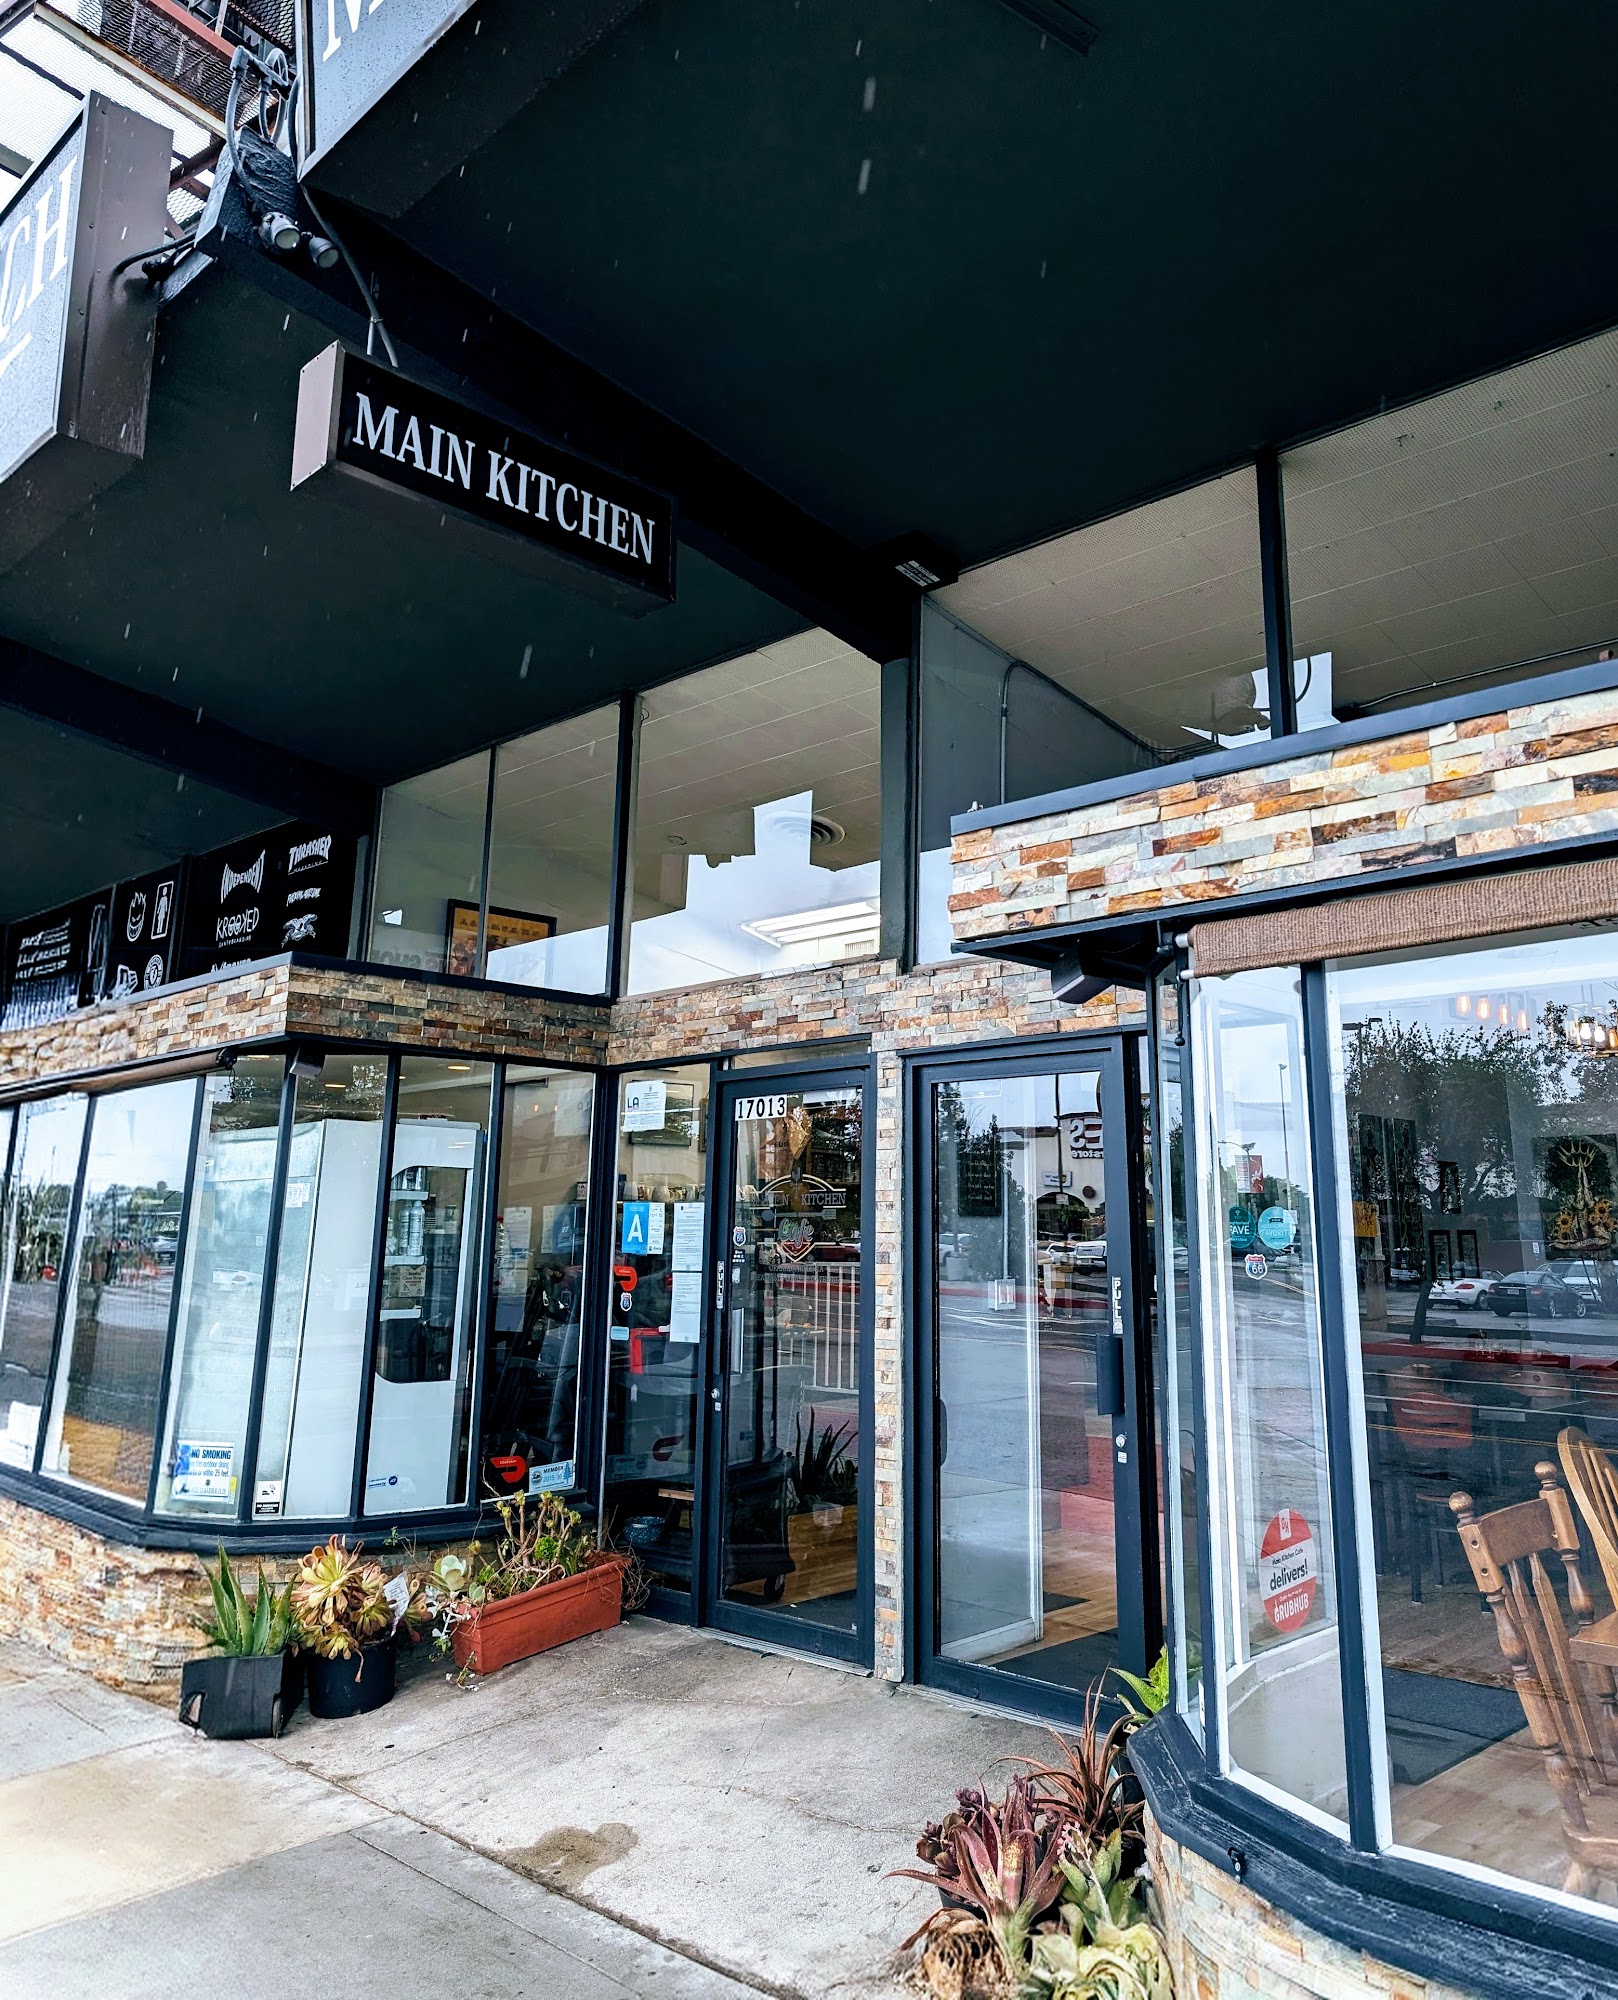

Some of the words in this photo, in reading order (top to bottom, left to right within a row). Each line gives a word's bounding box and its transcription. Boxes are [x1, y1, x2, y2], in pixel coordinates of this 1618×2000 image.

[352, 391, 476, 490] MAIN
[486, 449, 656, 565] KITCHEN
[288, 835, 332, 873] THRASHER
[221, 849, 266, 904] INDEPENDENT
[216, 907, 259, 941] KROOKED
[737, 1096, 786, 1119] 17013
[800, 1192, 847, 1206] KITCHEN
[626, 1213, 644, 1243] A
[1251, 1264, 1264, 1274] 66
[1114, 1280, 1122, 1319] PULL
[191, 1449, 200, 1459] NO
[202, 1449, 232, 1460] SMOKING
[543, 1465, 564, 1474] MEMBER
[215, 1469, 221, 1477] 25
[1270, 1558, 1308, 1591] delivers!
[1274, 1593, 1309, 1623] GRUBHUB
